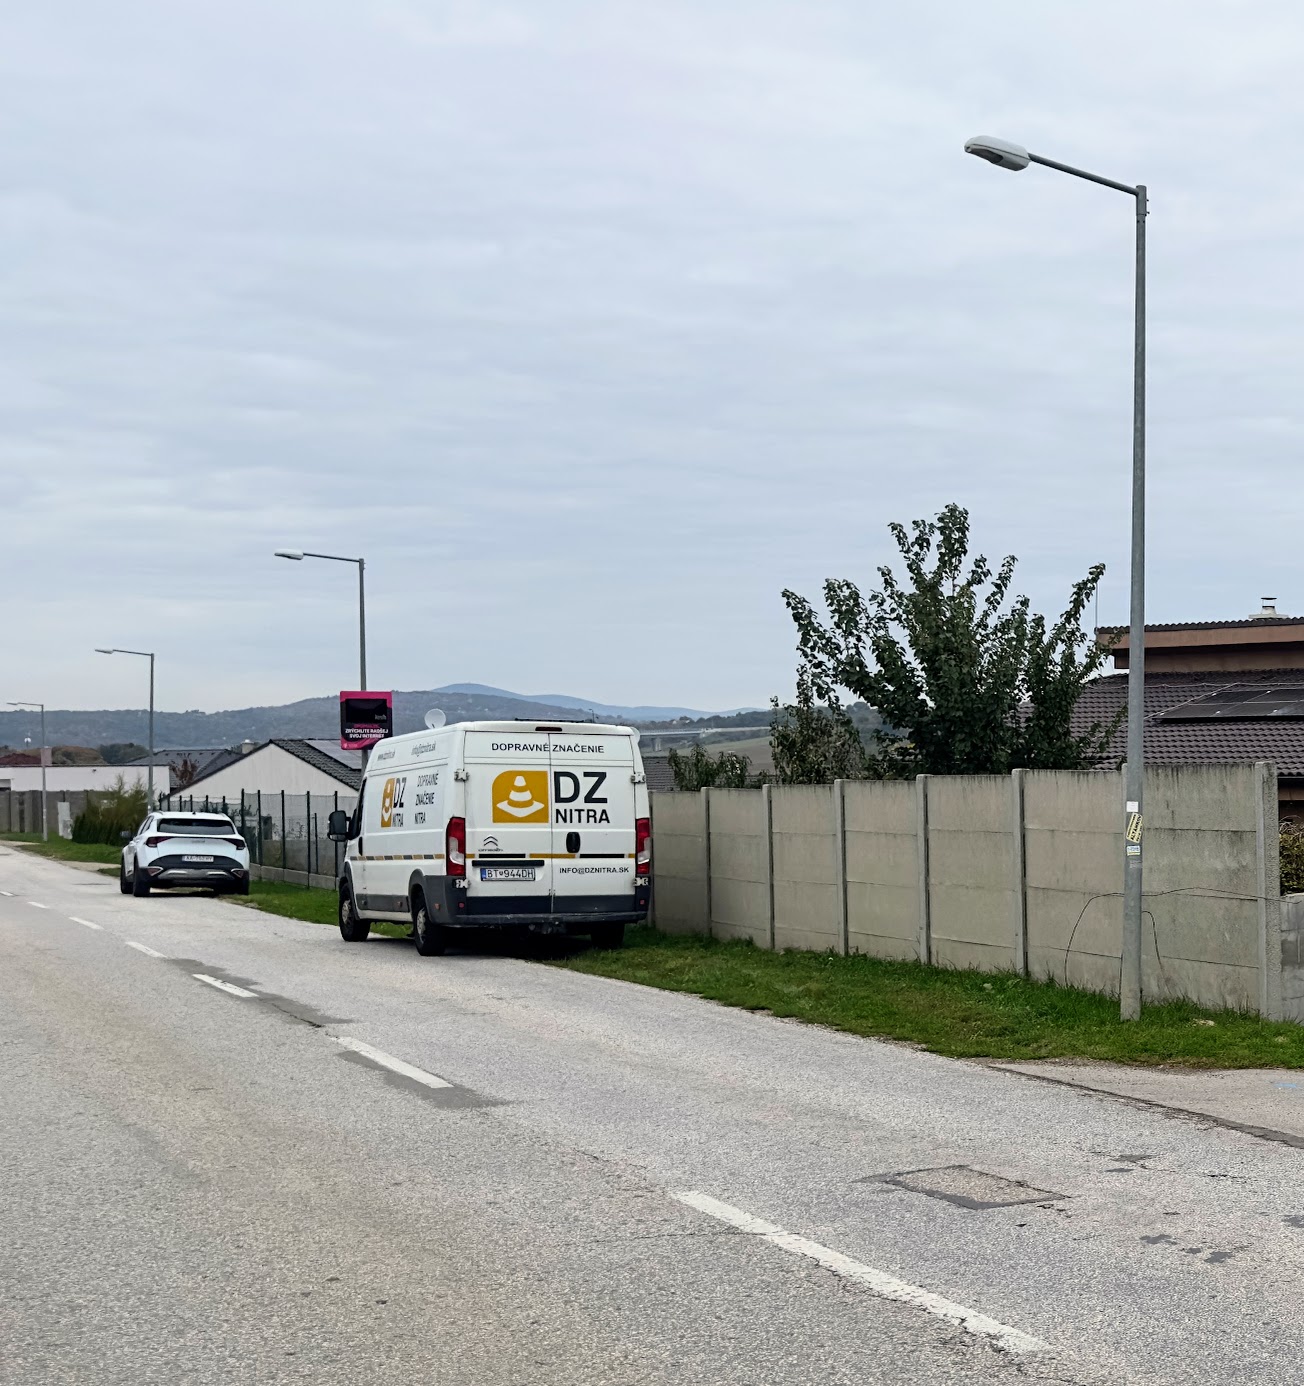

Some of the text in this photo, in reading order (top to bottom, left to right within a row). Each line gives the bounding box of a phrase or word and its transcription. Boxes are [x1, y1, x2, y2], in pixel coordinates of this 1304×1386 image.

[491, 742, 604, 753] DOPRAVNÉ ZNAČENIE
[393, 777, 407, 808] DZ
[554, 771, 608, 804] DZ
[414, 812, 426, 824] NITRA
[556, 808, 610, 824] NITRA
